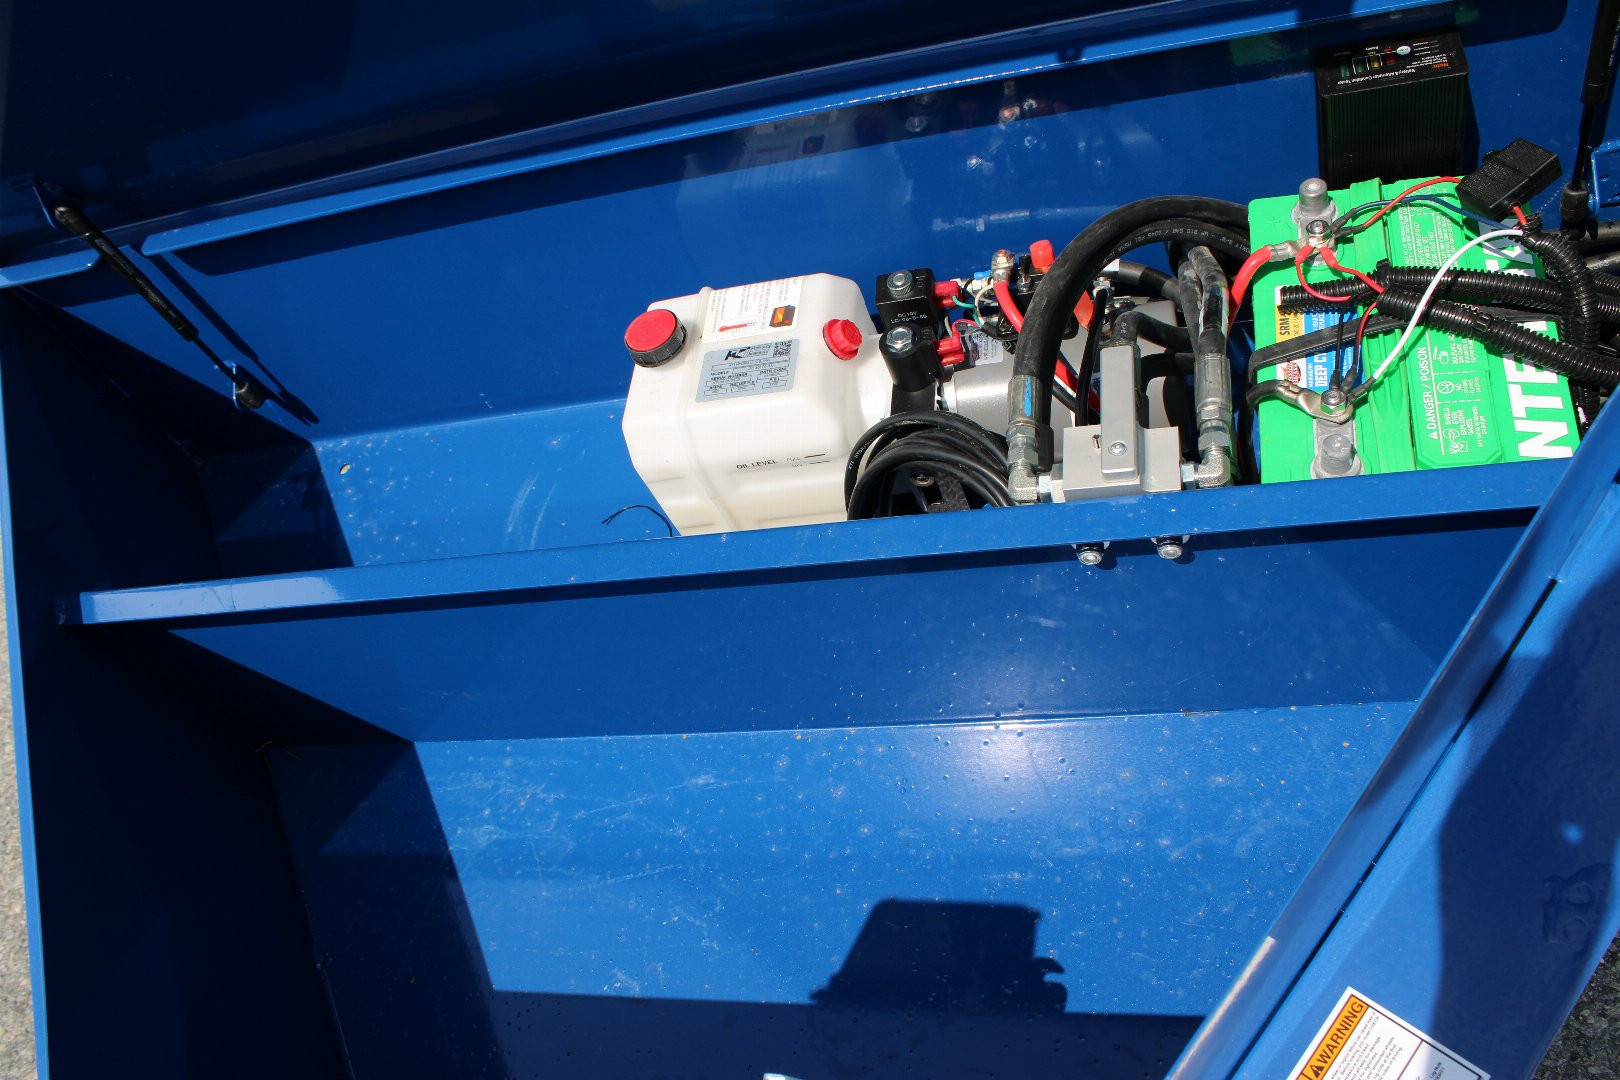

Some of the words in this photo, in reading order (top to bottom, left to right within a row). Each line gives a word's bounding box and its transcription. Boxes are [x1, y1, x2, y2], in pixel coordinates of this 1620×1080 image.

[1417, 347, 1429, 381] POISON
[1312, 363, 1329, 387] DEEP
[1423, 391, 1436, 429] DANGER
[1443, 406, 1451, 424] SHIELD
[1450, 411, 1458, 424] EYES
[750, 458, 777, 467] LEVEL
[1316, 1001, 1365, 1064] WARNING
[1368, 1036, 1381, 1052] damage
